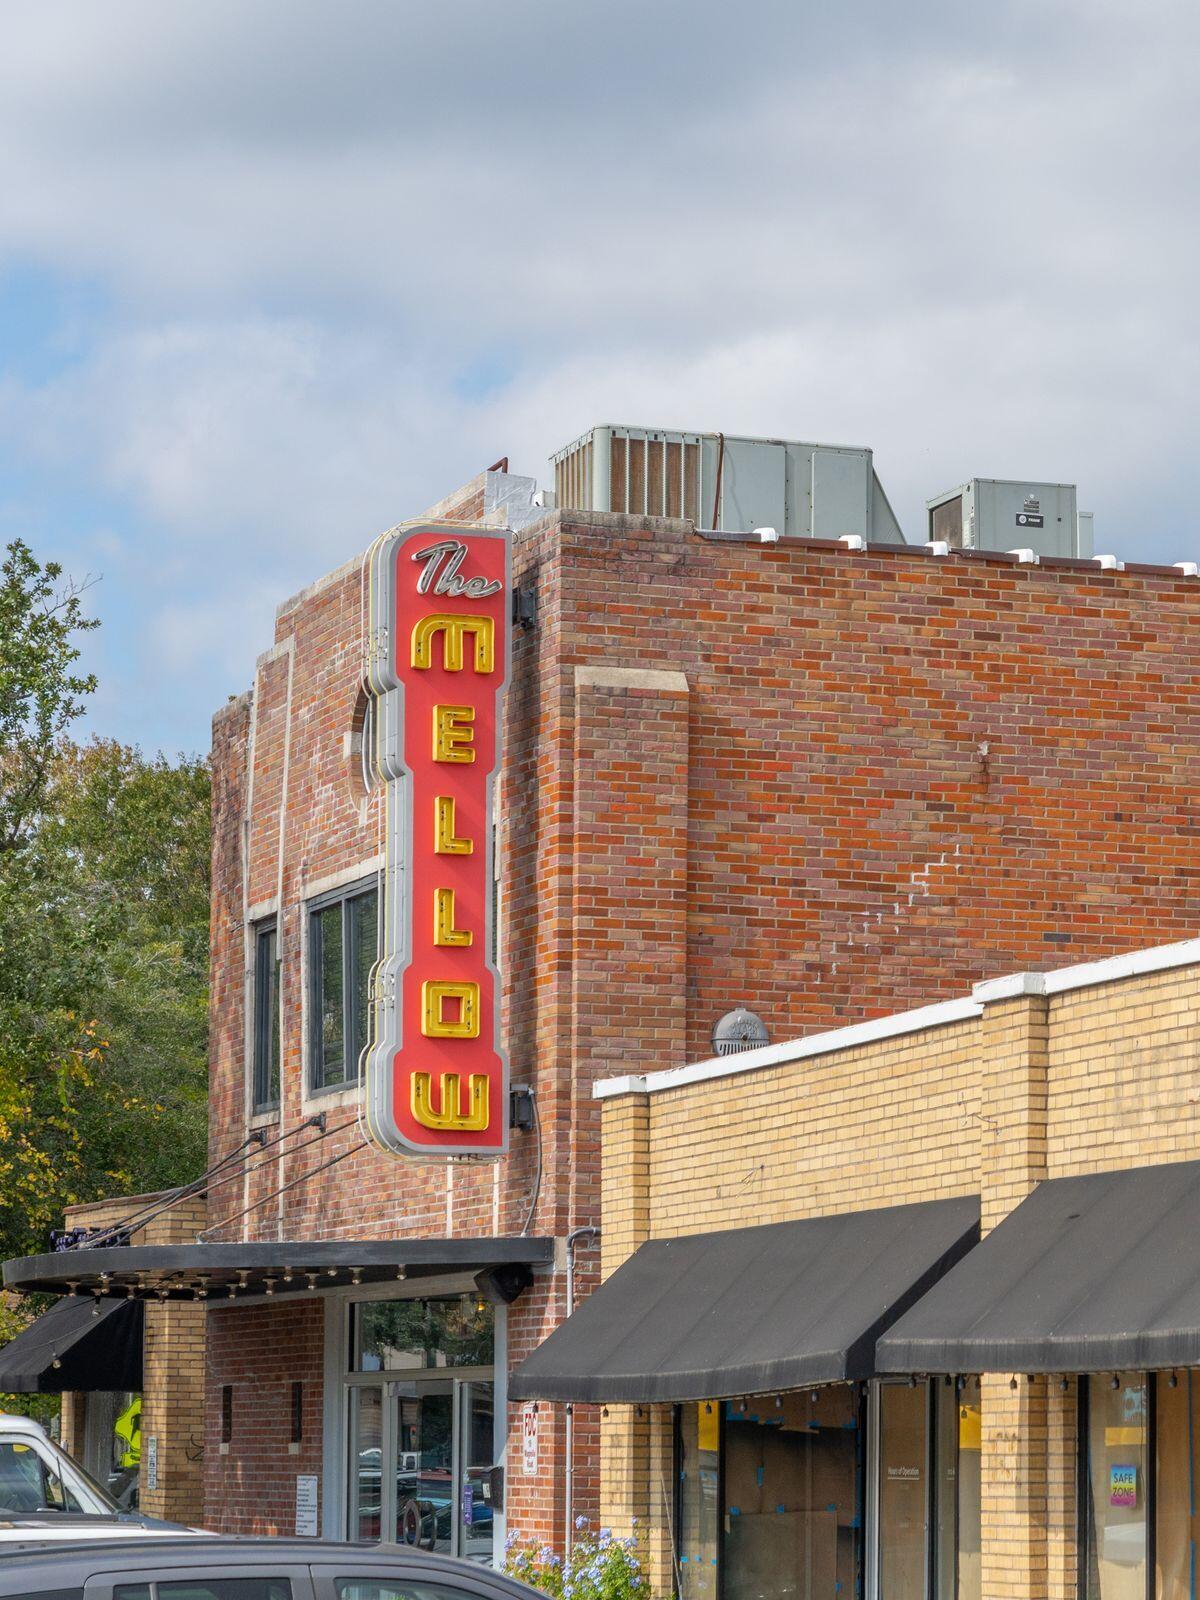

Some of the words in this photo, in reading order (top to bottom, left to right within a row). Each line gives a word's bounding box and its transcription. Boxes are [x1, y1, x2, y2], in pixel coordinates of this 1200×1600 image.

[411, 540, 503, 598] The
[1114, 1473, 1133, 1483] SAFE
[1113, 1488, 1134, 1497] ZONE
